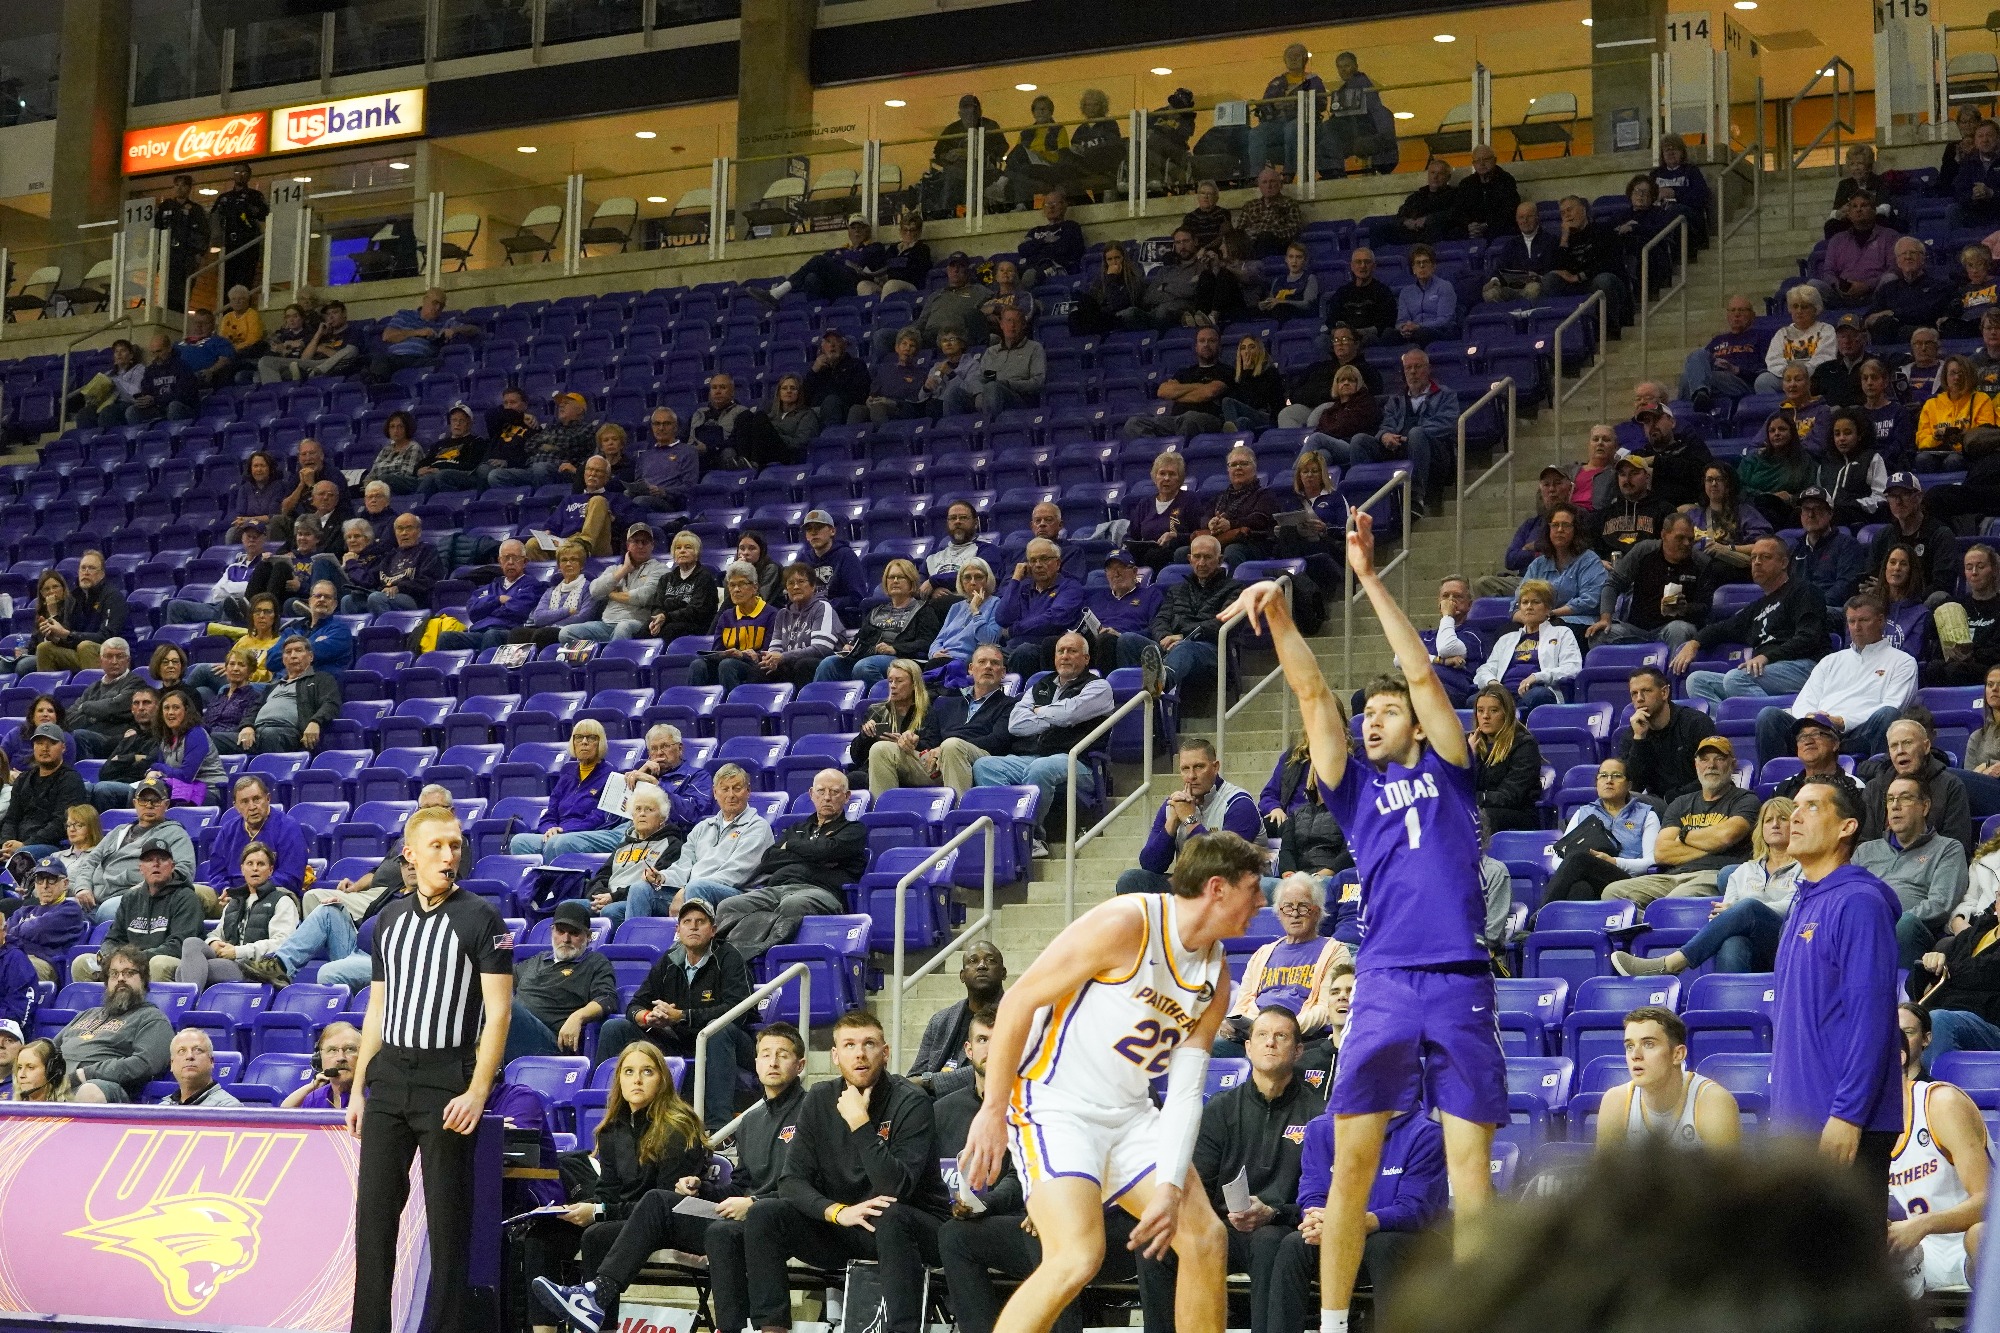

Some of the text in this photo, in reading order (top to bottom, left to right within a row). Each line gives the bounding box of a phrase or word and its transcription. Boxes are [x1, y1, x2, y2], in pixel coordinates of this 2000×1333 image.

[1667, 19, 1709, 42] 114
[1886, 0, 1928, 19] 115
[129, 116, 263, 162] enjoy Coca-Cola
[127, 205, 152, 223] 113
[273, 185, 301, 205] 114
[1375, 772, 1439, 816] LORAS
[1404, 806, 1421, 850] 1
[1259, 964, 1315, 988] PANTHERS
[1134, 986, 1197, 1033] PATHER
[1113, 1019, 1181, 1073] 22
[85, 1129, 308, 1224] UNI
